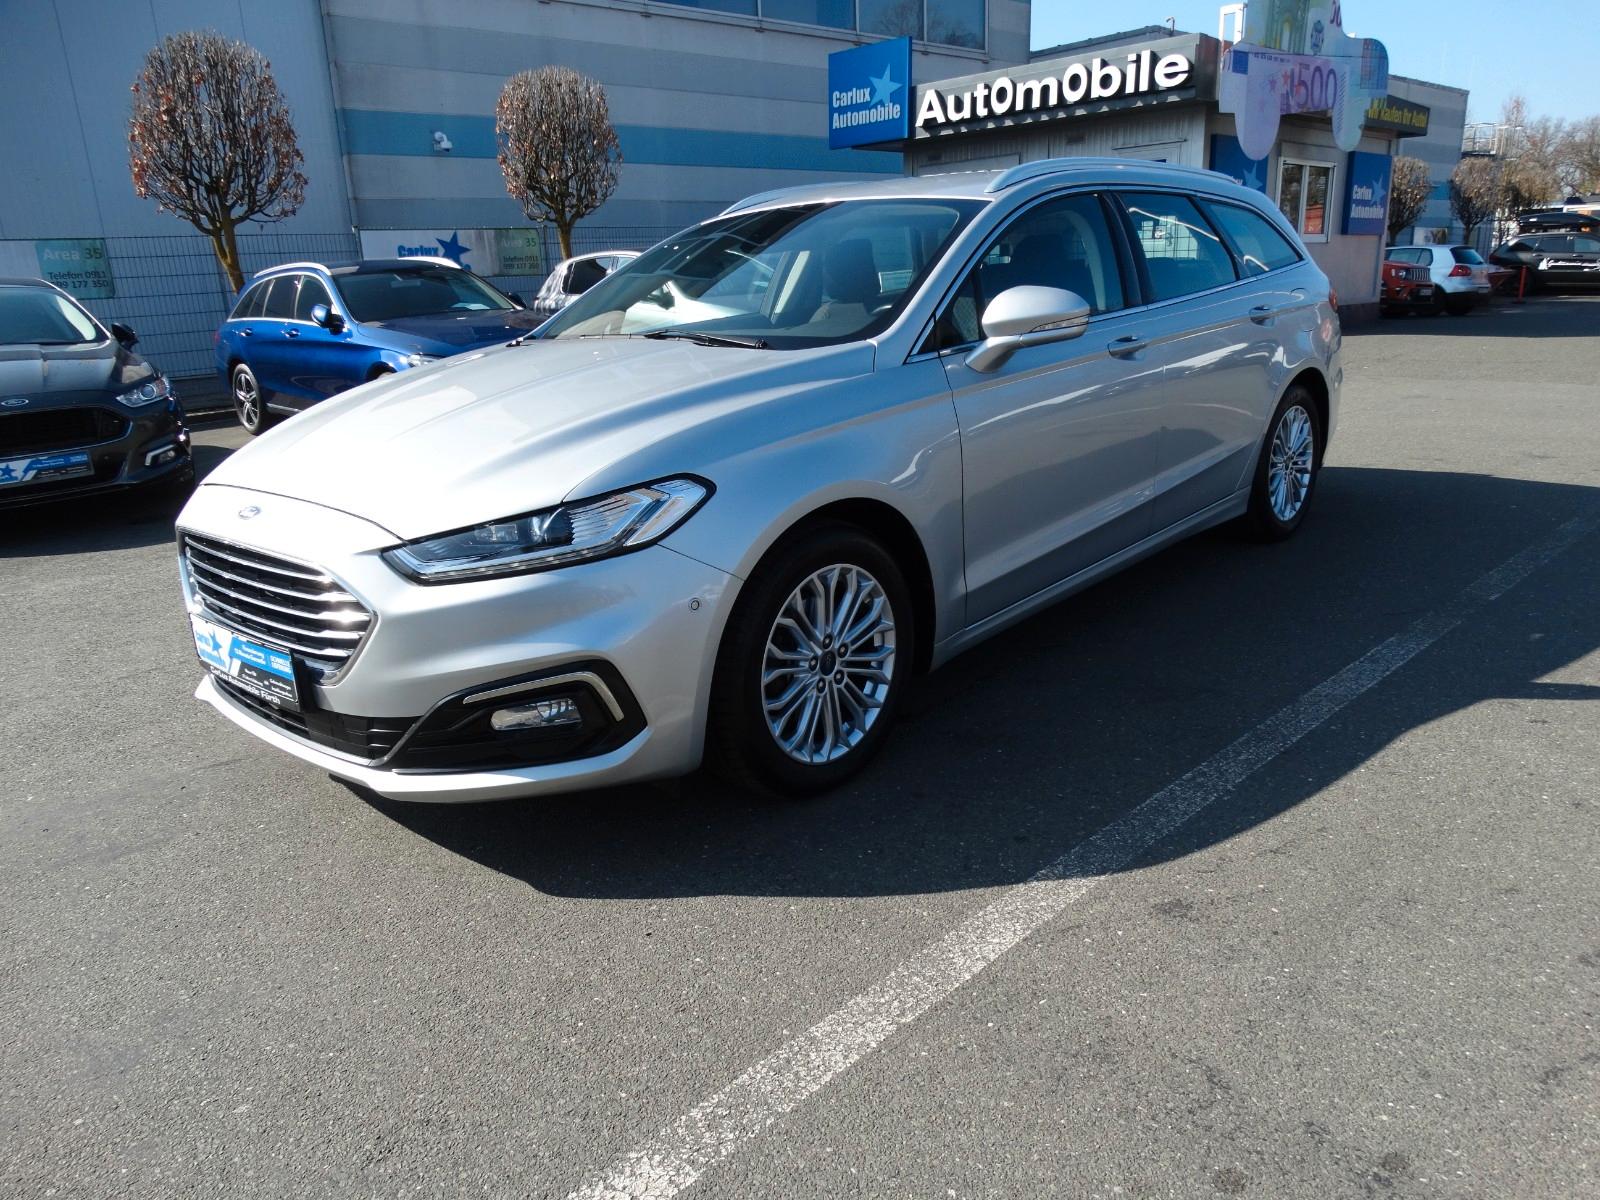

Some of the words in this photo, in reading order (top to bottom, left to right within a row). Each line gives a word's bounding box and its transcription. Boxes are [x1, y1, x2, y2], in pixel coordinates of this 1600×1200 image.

[832, 87, 871, 108] Carlux
[832, 102, 901, 129] Automobile
[1350, 203, 1385, 219] Automobile
[525, 237, 537, 248] 35
[43, 248, 81, 260] Area
[84, 246, 103, 260] 35
[47, 271, 84, 280] Telefon
[71, 280, 88, 289] 177
